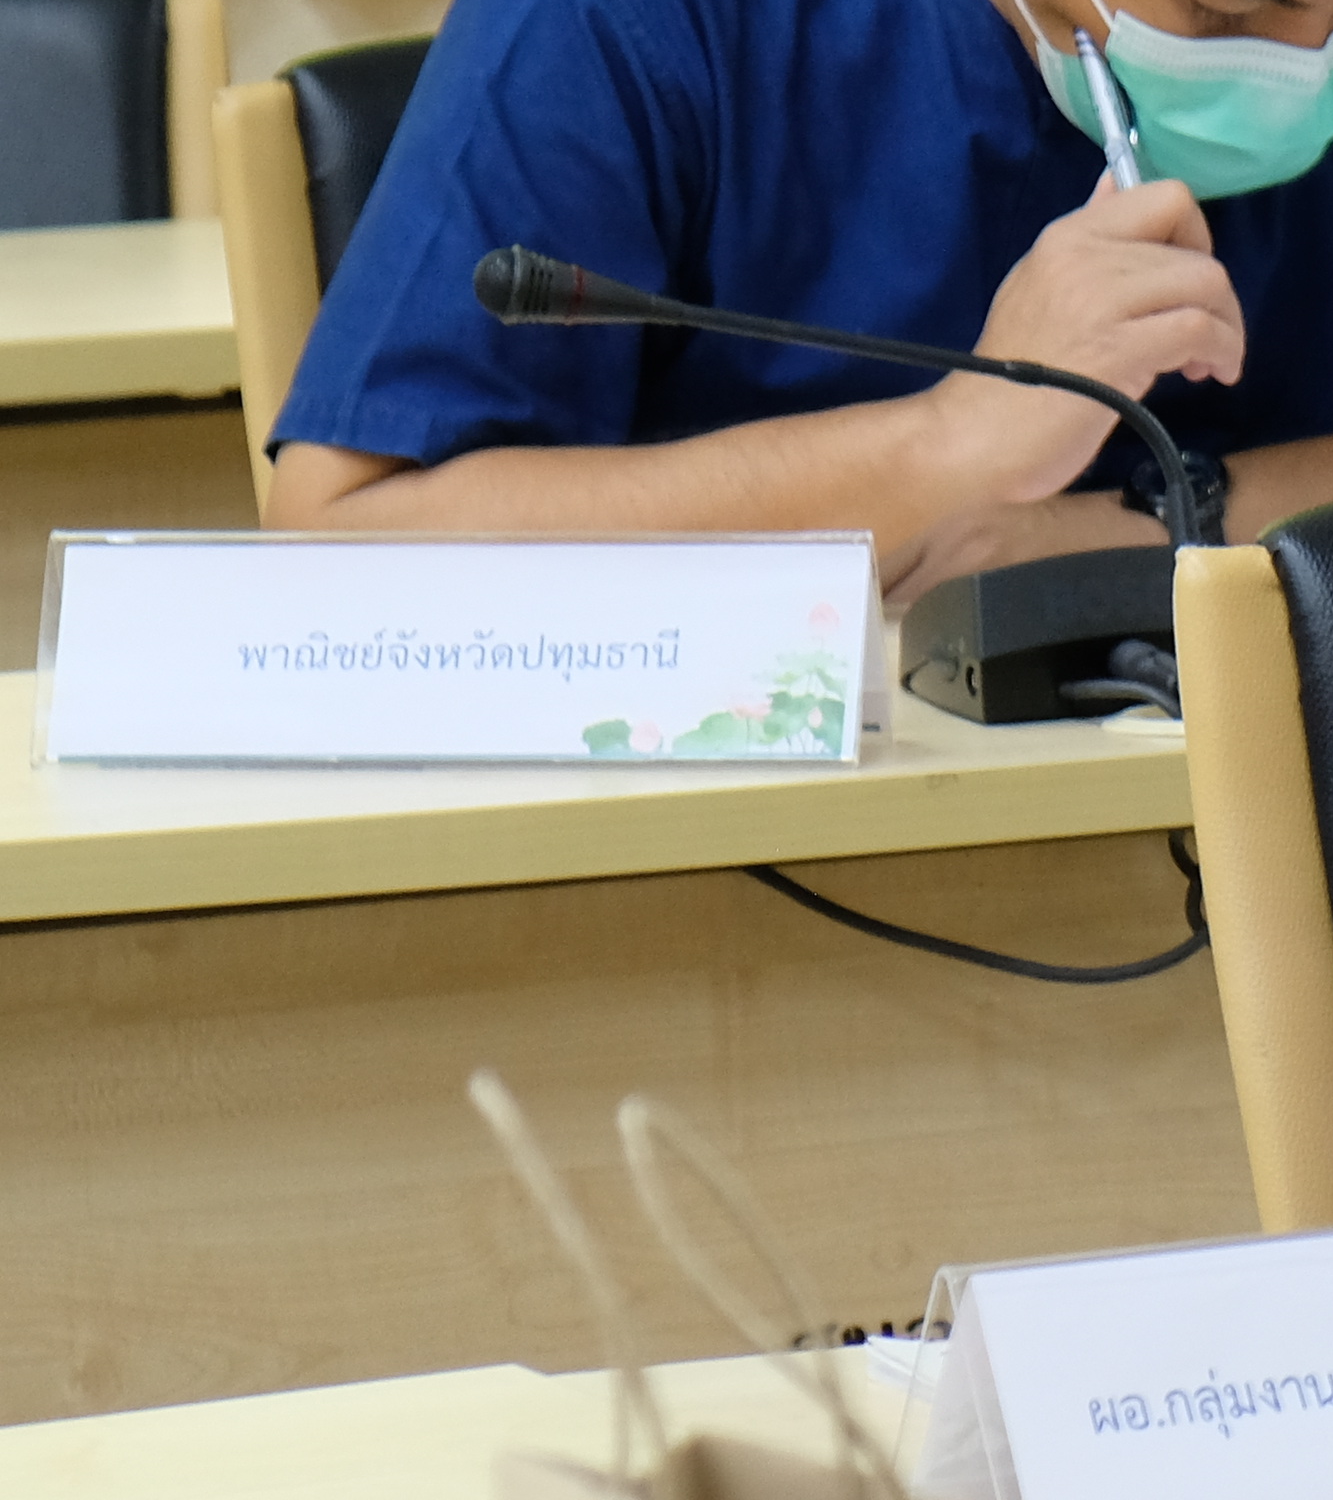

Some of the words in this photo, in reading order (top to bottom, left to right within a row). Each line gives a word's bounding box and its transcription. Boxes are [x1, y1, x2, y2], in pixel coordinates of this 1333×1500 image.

[238, 627, 682, 683] พาณิชย์จังหวัดปทุมธานี
